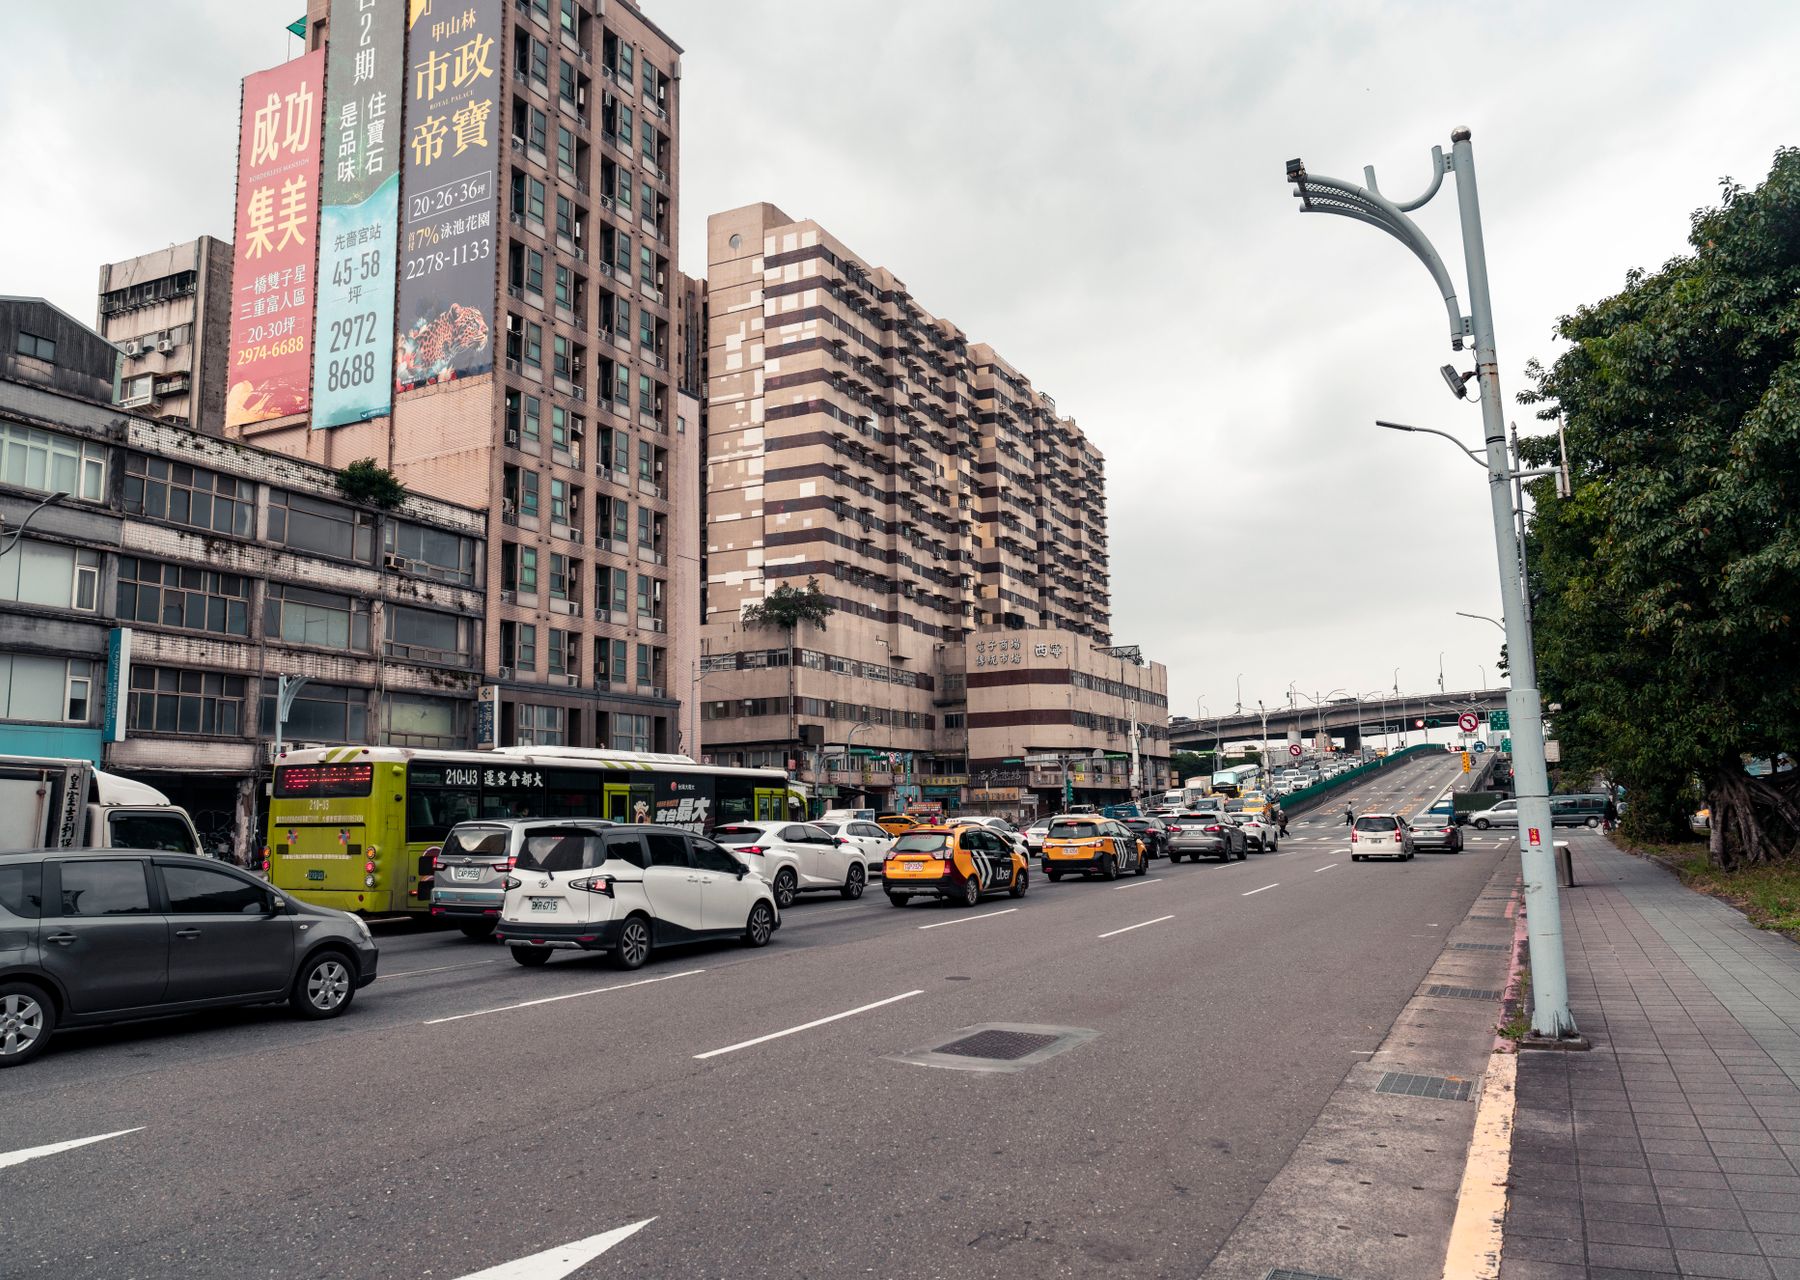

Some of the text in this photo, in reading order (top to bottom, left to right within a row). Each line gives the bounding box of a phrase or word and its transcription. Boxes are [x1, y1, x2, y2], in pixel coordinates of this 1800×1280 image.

[431, 7, 477, 43] 甲山林
[413, 32, 496, 101] 市政
[249, 80, 315, 169] 成功
[337, 100, 359, 183] 是品味
[365, 91, 388, 176] 住寶石
[410, 98, 494, 167] 帝寶
[244, 173, 308, 260] 集美
[241, 264, 307, 296] 一橋雙子星
[332, 249, 380, 287] 45-58
[406, 238, 490, 280] 2278-1133
[239, 289, 306, 321] 三重富人區
[347, 285, 363, 305] 坪
[236, 336, 305, 366] 2974-6688
[329, 311, 378, 354] 2972
[327, 351, 376, 393] 8688
[445, 768, 478, 785] 210-U3
[996, 867, 1011, 880] Uber
